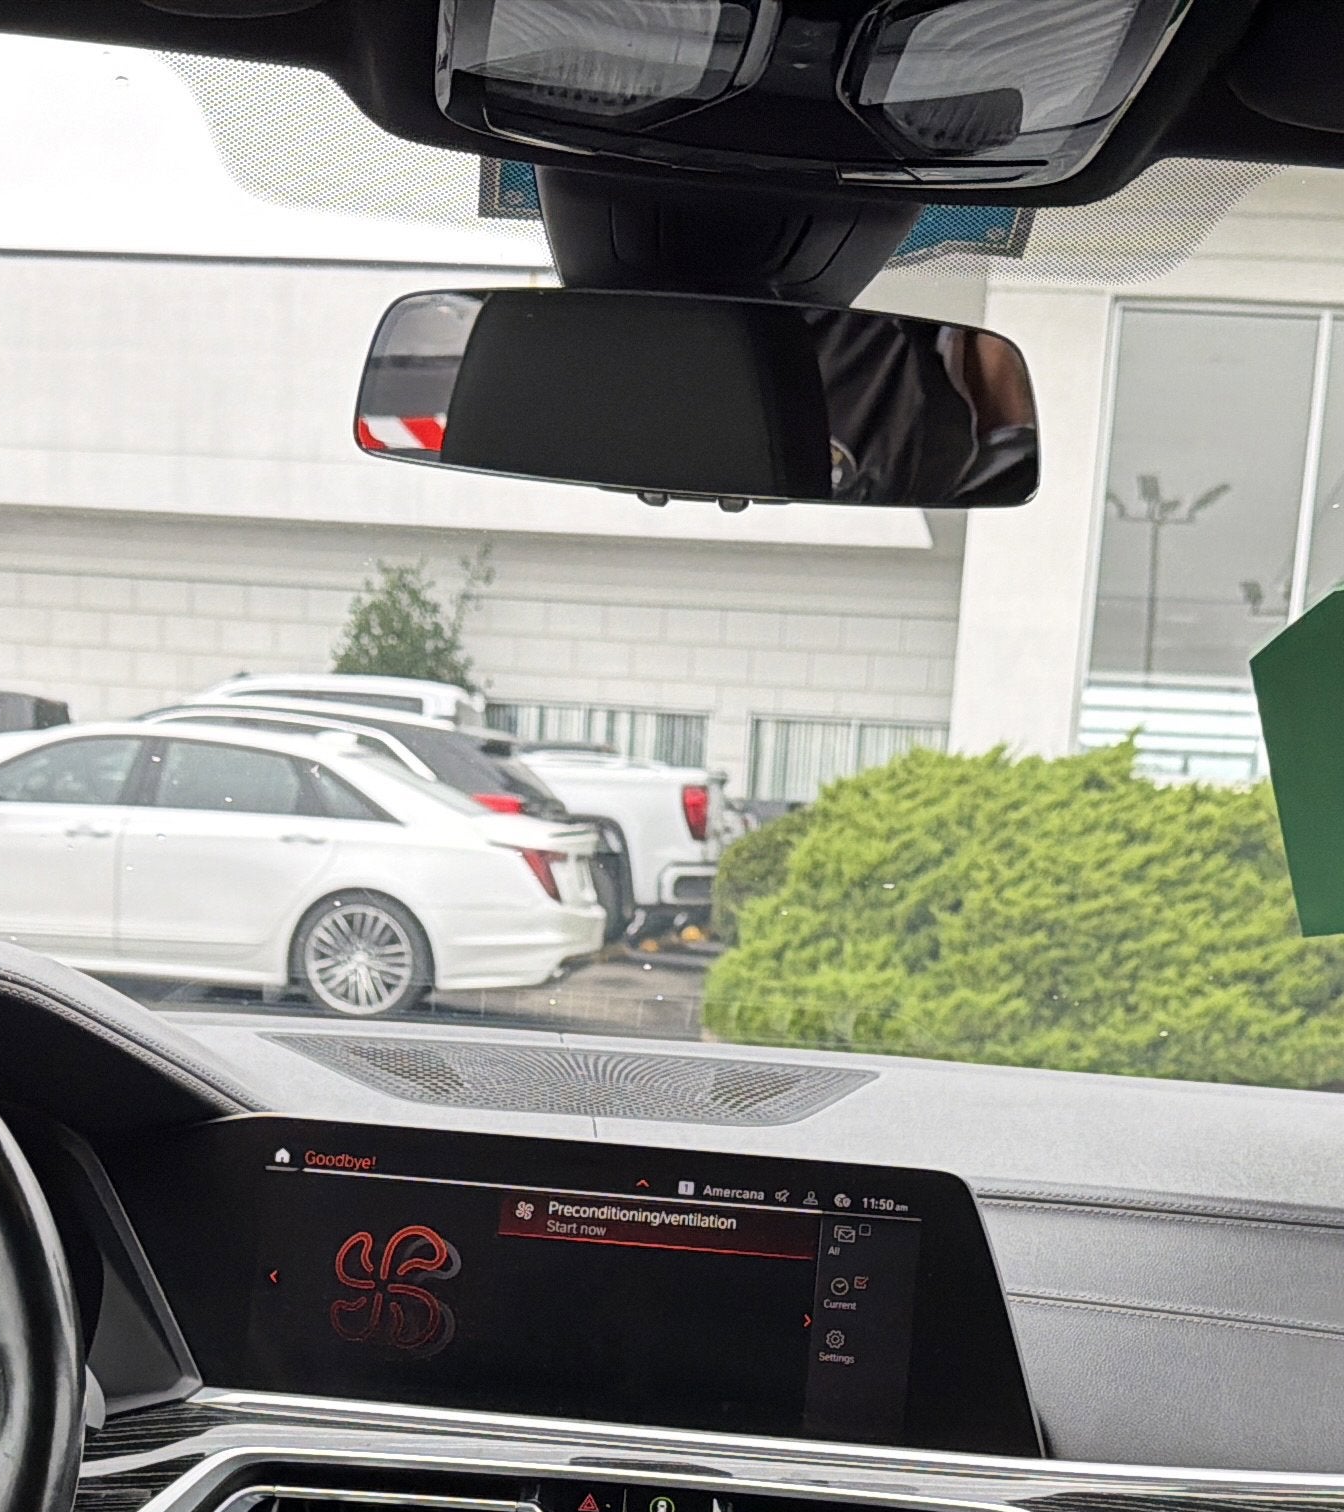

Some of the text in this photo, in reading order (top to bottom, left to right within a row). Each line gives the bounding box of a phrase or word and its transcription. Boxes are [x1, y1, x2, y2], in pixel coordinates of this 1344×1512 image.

[305, 1150, 376, 1170] Goodbye!
[703, 1184, 765, 1201] Amercana
[862, 1197, 894, 1211] 11:50
[548, 1201, 737, 1230] Preconditioning/ventilation
[546, 1219, 606, 1237] Start now
[827, 1245, 840, 1256] All
[823, 1299, 856, 1310] Current
[818, 1352, 854, 1364] Settings
